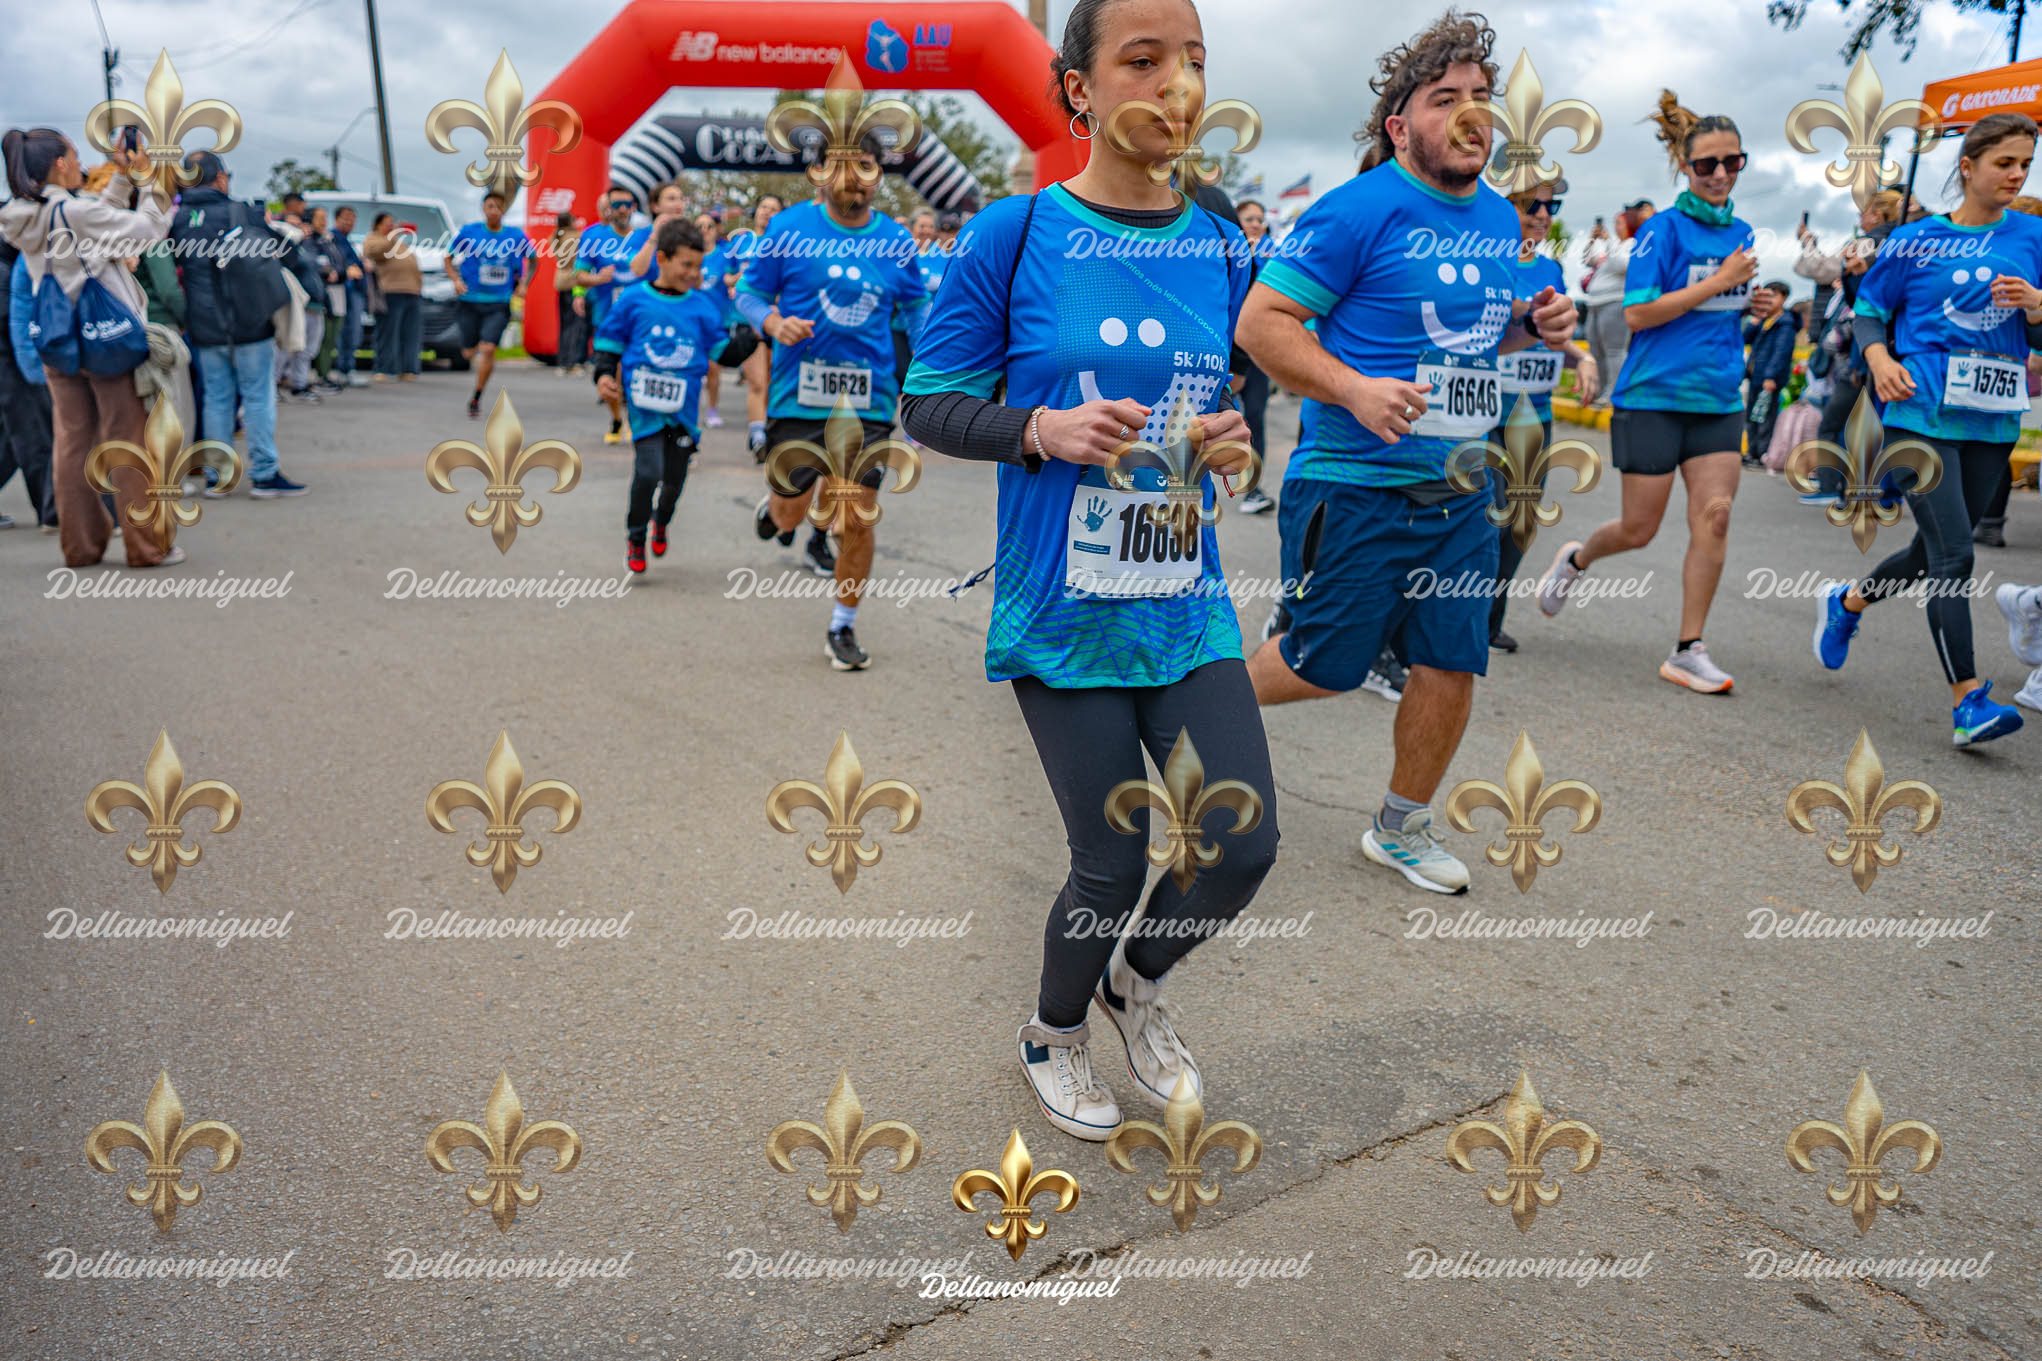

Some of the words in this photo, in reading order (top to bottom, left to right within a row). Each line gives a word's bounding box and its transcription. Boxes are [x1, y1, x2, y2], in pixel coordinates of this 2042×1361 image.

[717, 44, 754, 61] new
[757, 43, 838, 65] balance
[1961, 84, 2040, 111] GATORADE
[1193, 313, 1215, 335] TODO
[1517, 358, 1556, 381] 15738
[1974, 365, 2018, 398] 15755
[644, 378, 681, 401] 16637
[822, 372, 867, 396] 16628
[1447, 376, 1498, 417] 16646
[1119, 503, 1200, 563] 16638
